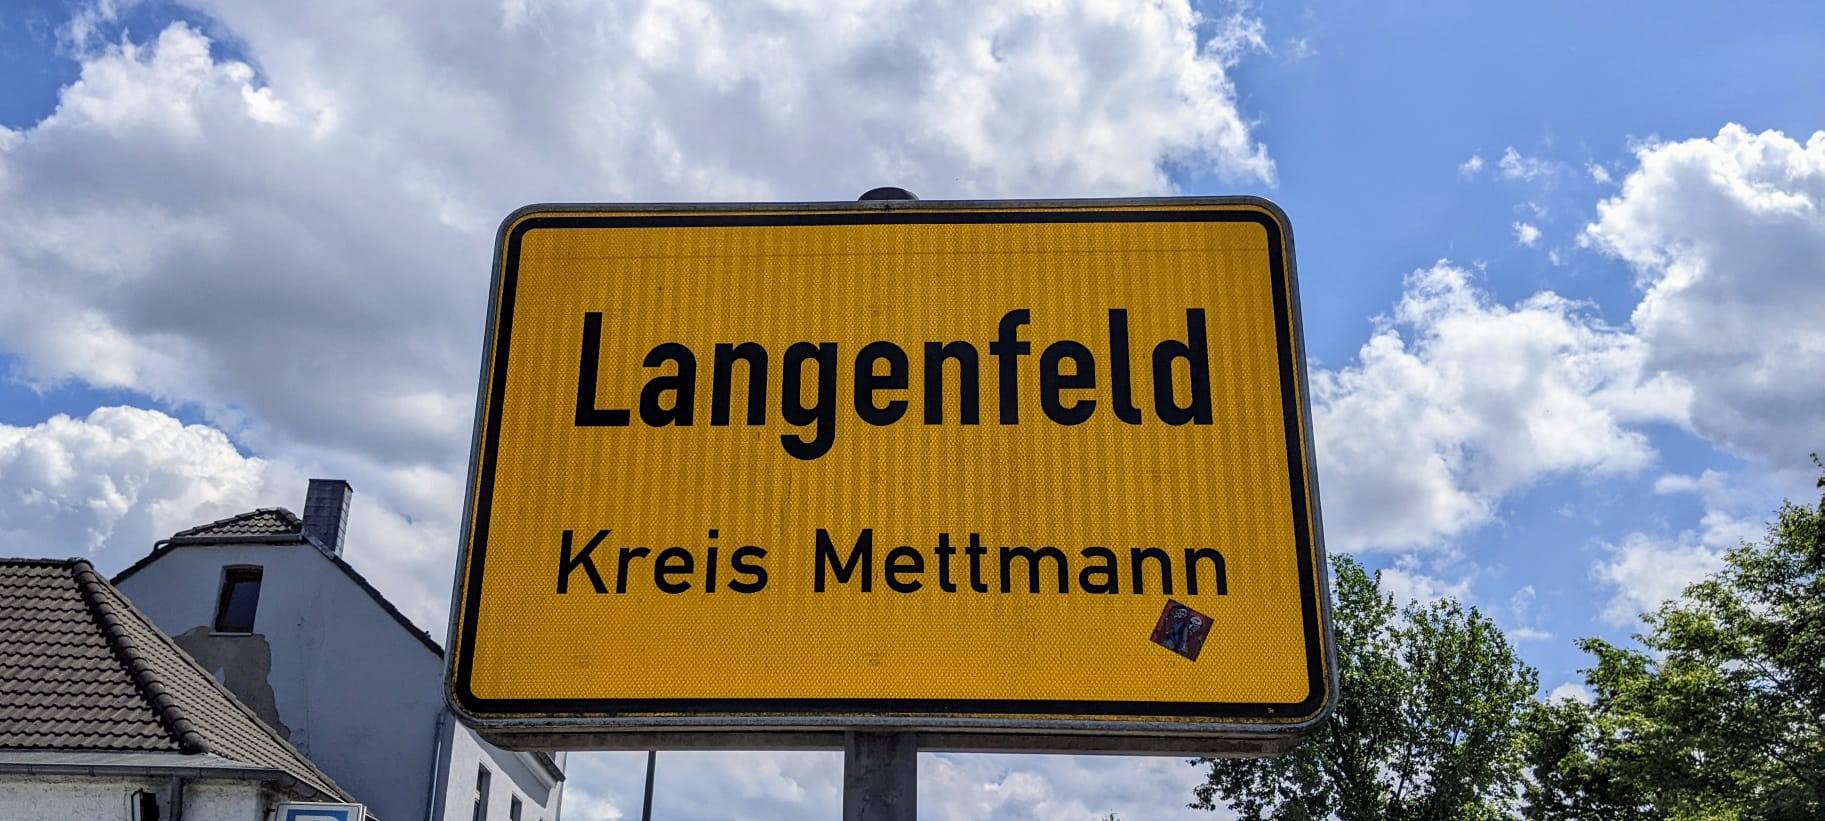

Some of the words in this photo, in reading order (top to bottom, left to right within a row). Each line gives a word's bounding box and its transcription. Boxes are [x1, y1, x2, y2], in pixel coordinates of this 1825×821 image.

[574, 307, 1214, 461] Langenfeld
[556, 528, 769, 595] Kreis
[813, 528, 1229, 596] Mettmann
